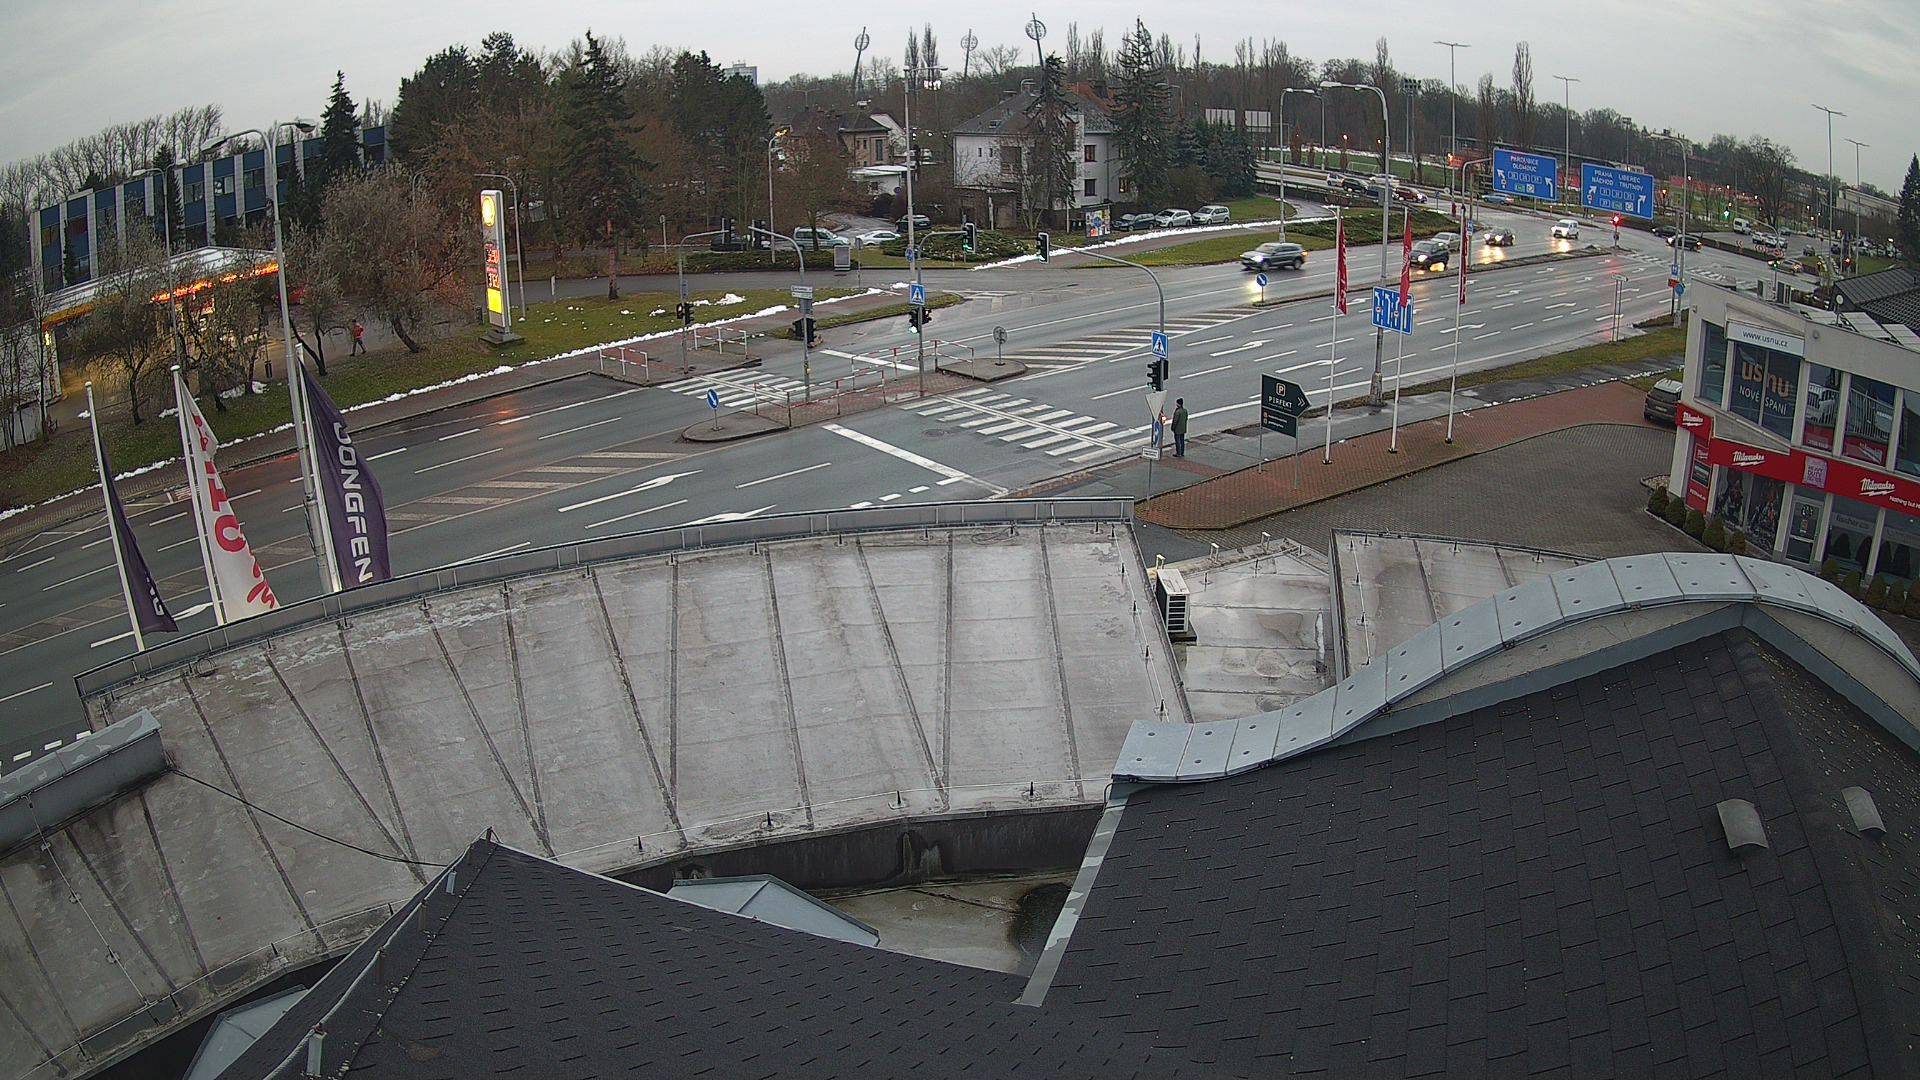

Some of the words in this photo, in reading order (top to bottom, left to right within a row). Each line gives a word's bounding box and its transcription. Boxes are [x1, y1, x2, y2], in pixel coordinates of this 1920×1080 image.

[1594, 169, 1613, 178] PRAHA
[1618, 174, 1641, 183] LIBEREC
[1619, 182, 1644, 192] TRUTNOV
[1742, 330, 1788, 348] www.usnu.cz
[1278, 385, 1284, 394] P
[1739, 384, 1760, 402] NOVÉ
[1732, 450, 1765, 462] Milwaukee
[1861, 478, 1895, 490] Milwaukee
